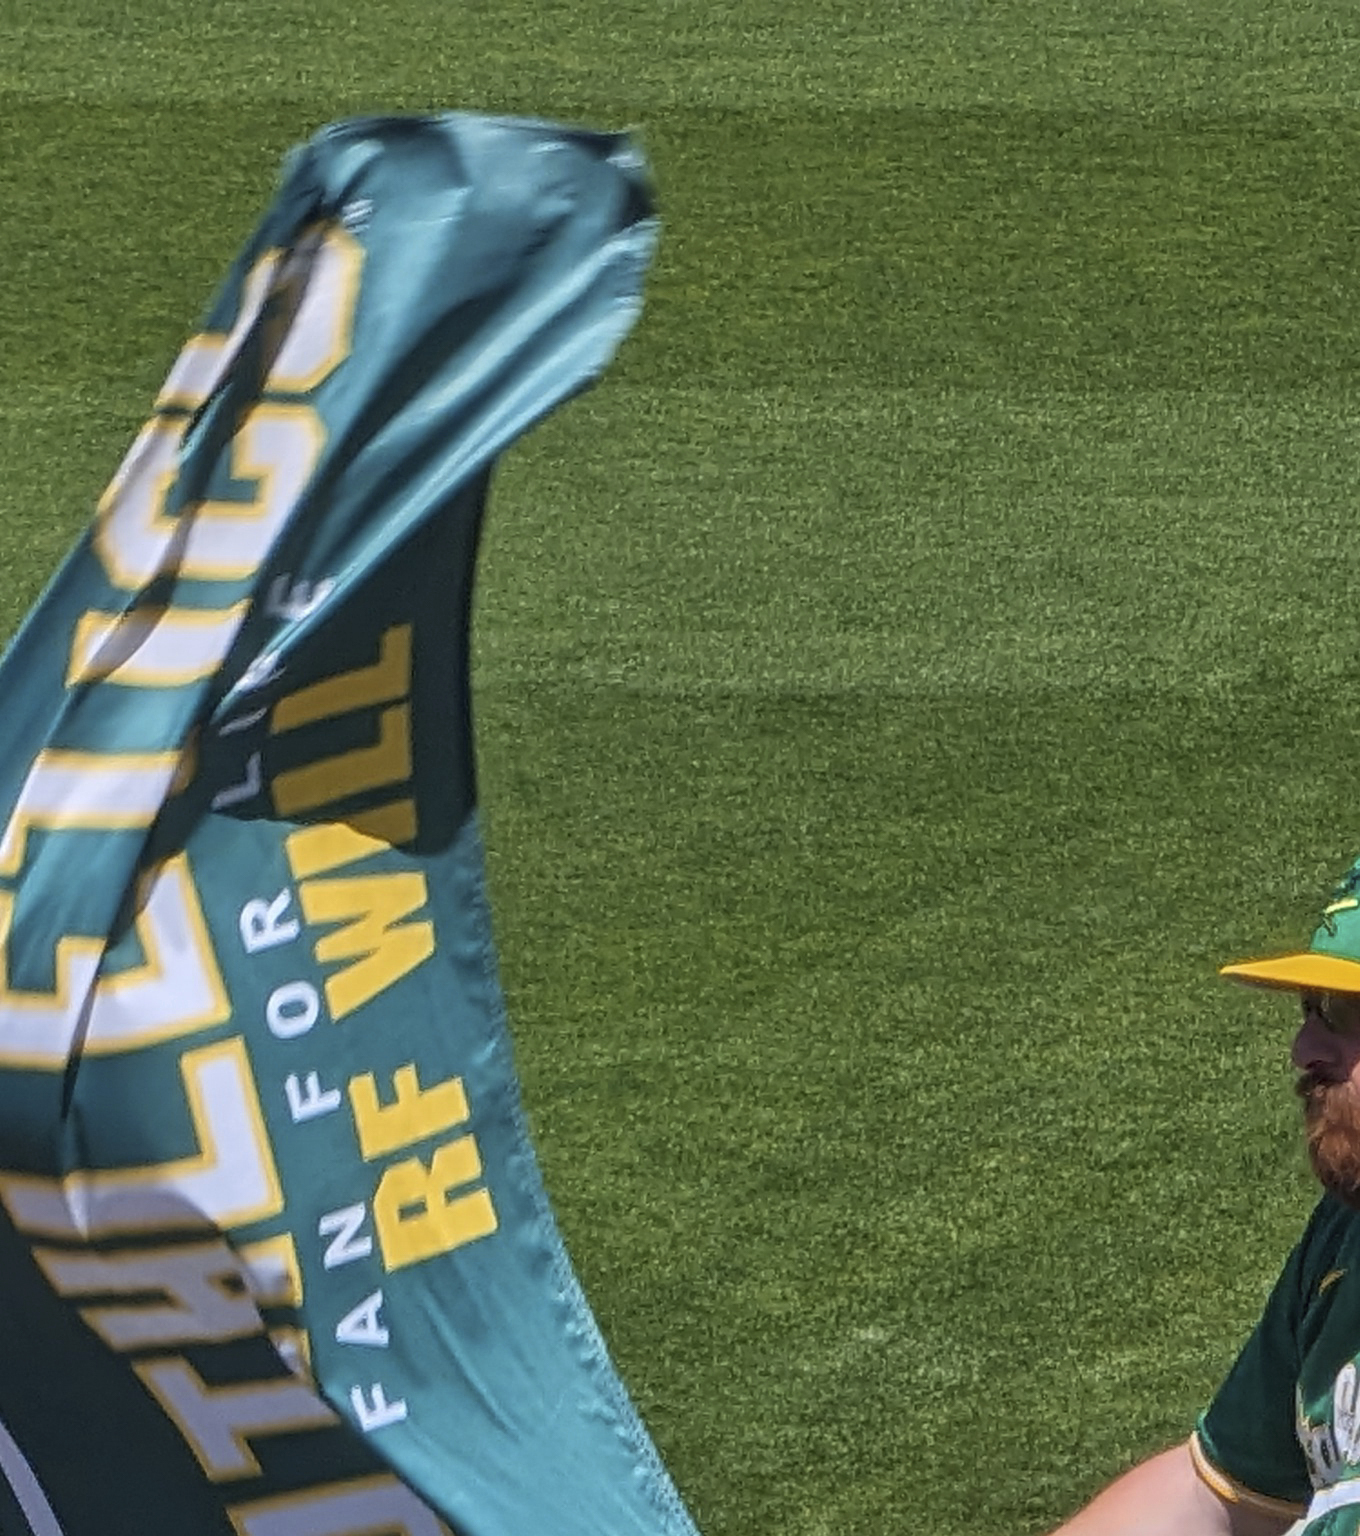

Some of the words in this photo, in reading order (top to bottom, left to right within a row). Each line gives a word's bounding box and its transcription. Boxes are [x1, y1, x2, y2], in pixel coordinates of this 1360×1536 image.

[268, 622, 435, 1025] WILL
[239, 887, 341, 1123] FOR
[348, 1062, 499, 1274] RF
[318, 1201, 408, 1432] FAN
